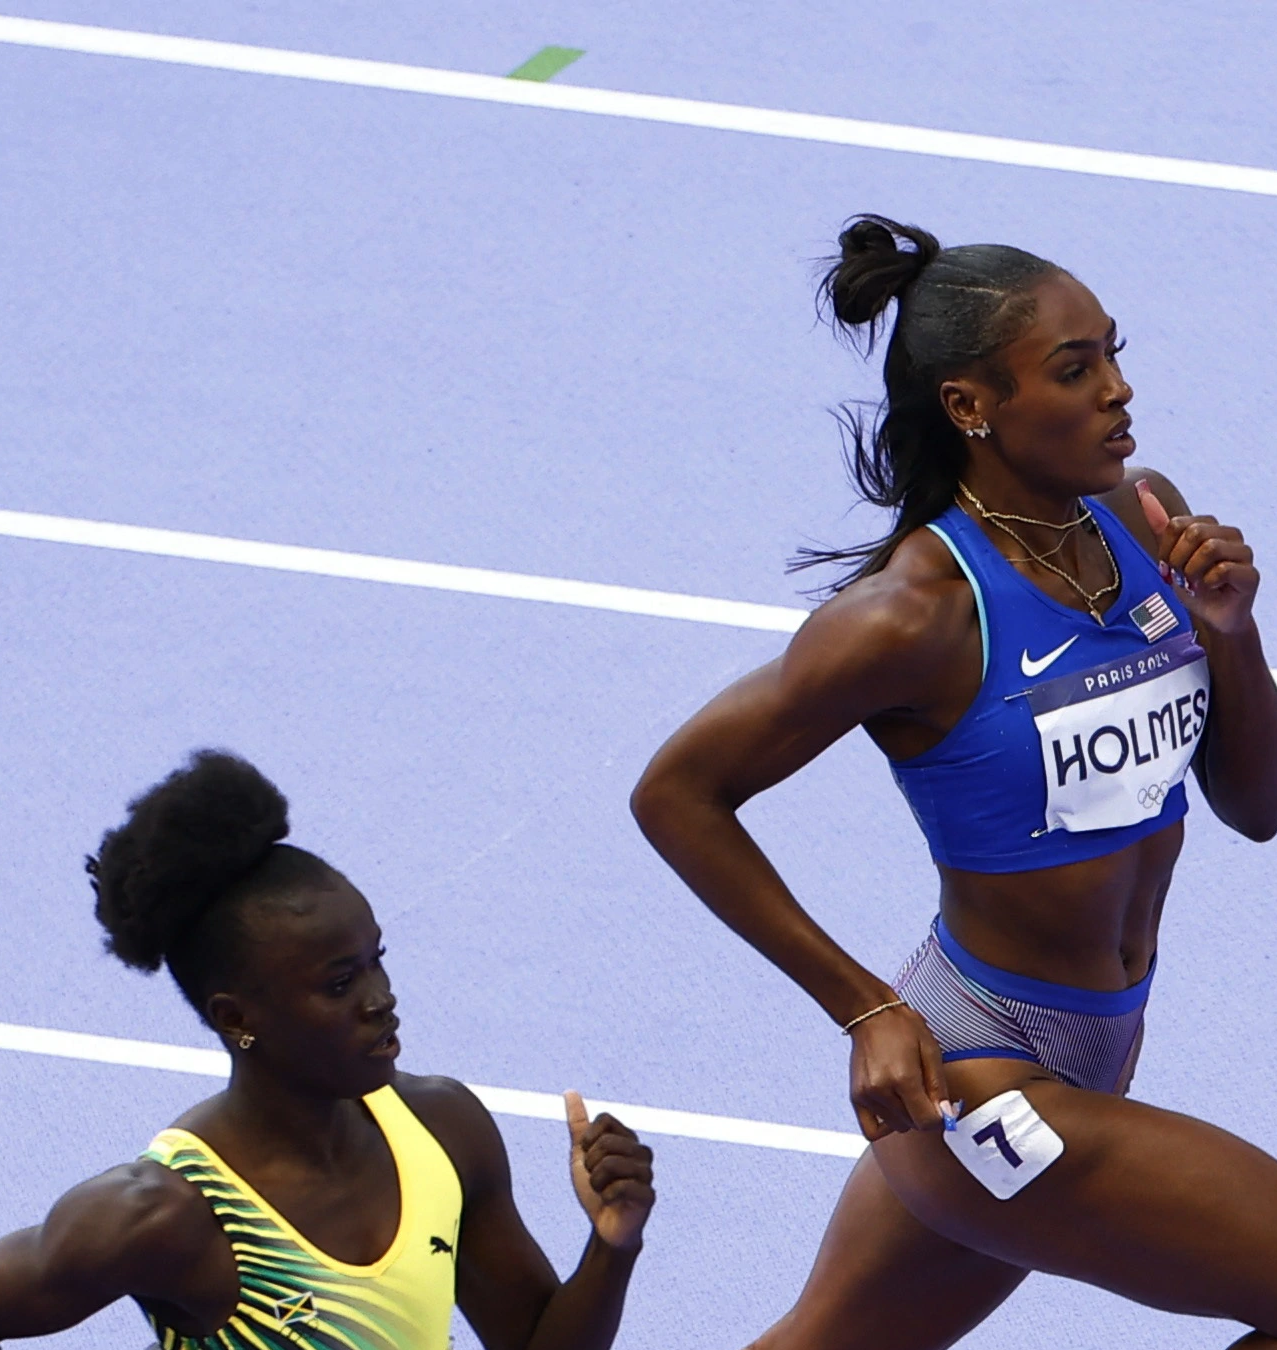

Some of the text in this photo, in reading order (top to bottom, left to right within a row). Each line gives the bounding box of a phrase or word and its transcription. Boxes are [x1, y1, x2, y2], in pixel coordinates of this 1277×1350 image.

[1084, 651, 1170, 691] PARIS 2024
[1052, 688, 1206, 787] HOLMES
[972, 1117, 1023, 1169] 7
